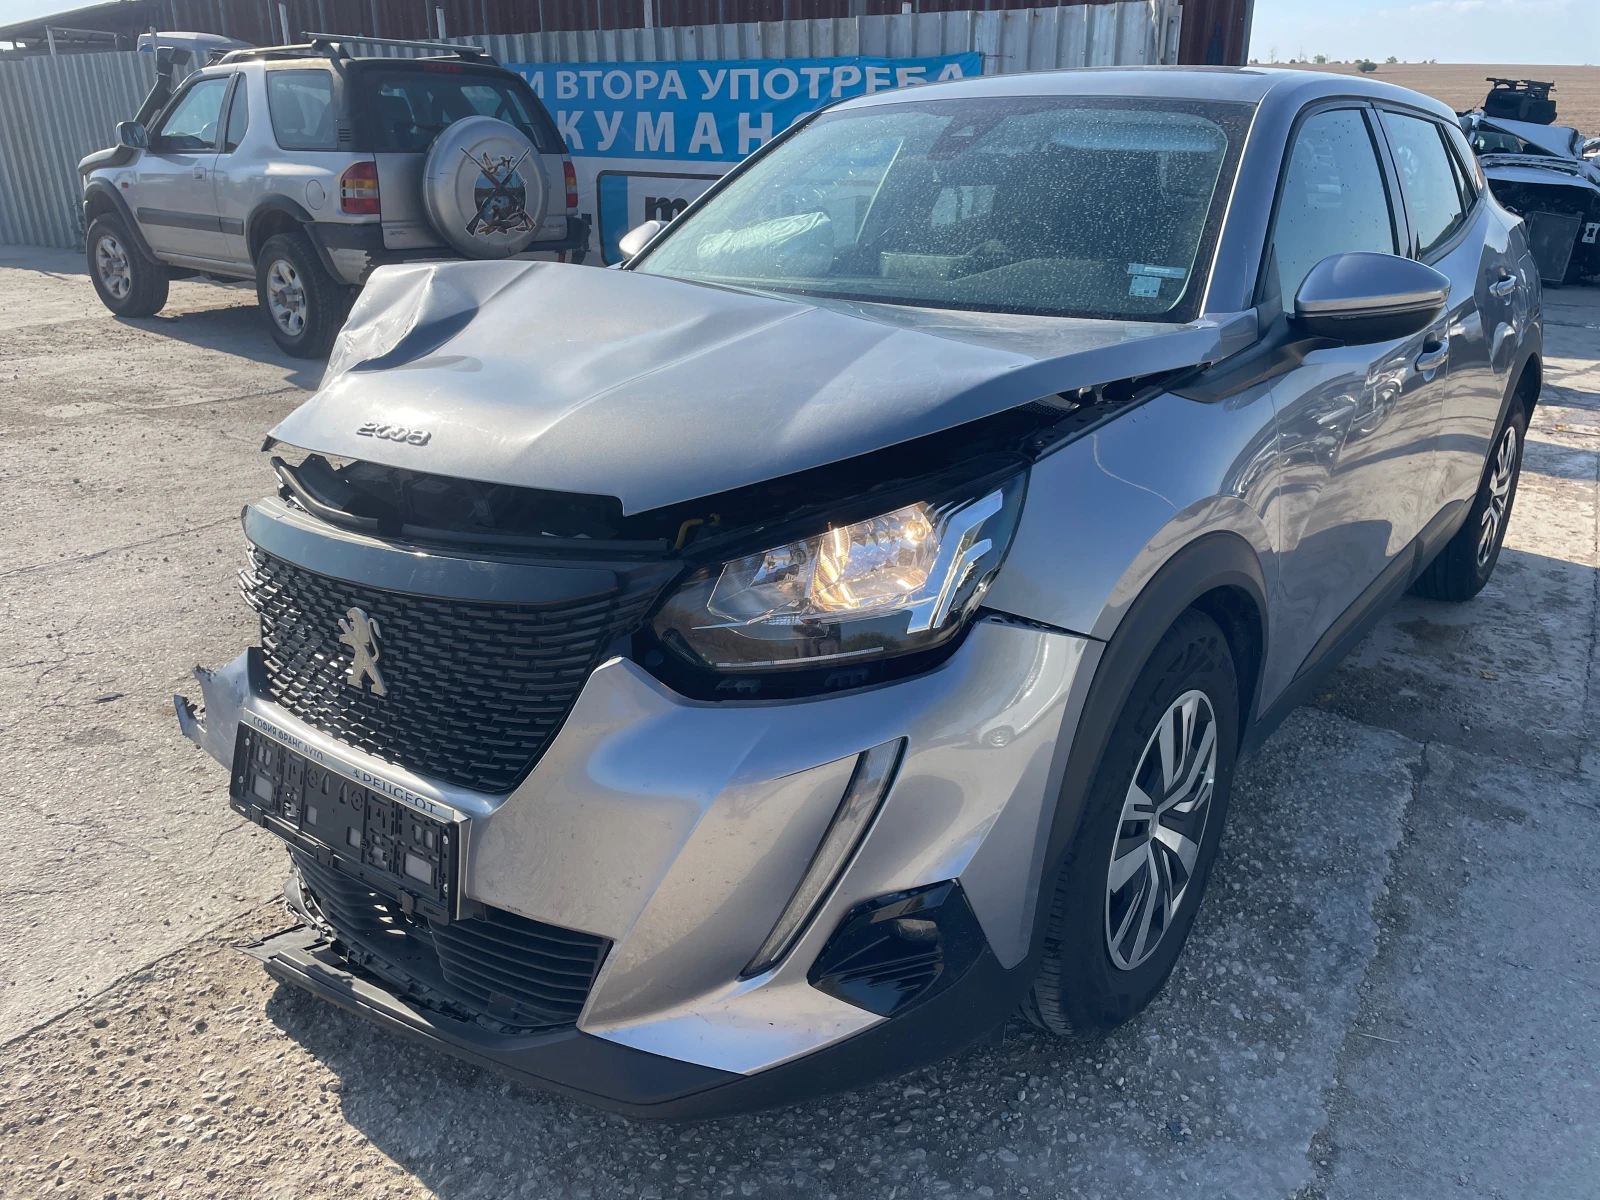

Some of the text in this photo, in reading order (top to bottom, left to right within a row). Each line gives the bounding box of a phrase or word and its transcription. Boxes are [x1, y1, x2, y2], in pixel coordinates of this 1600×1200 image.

[556, 69, 687, 101] ВТОРА
[356, 421, 432, 446] 2008
[363, 773, 437, 813] PEUGEOT
